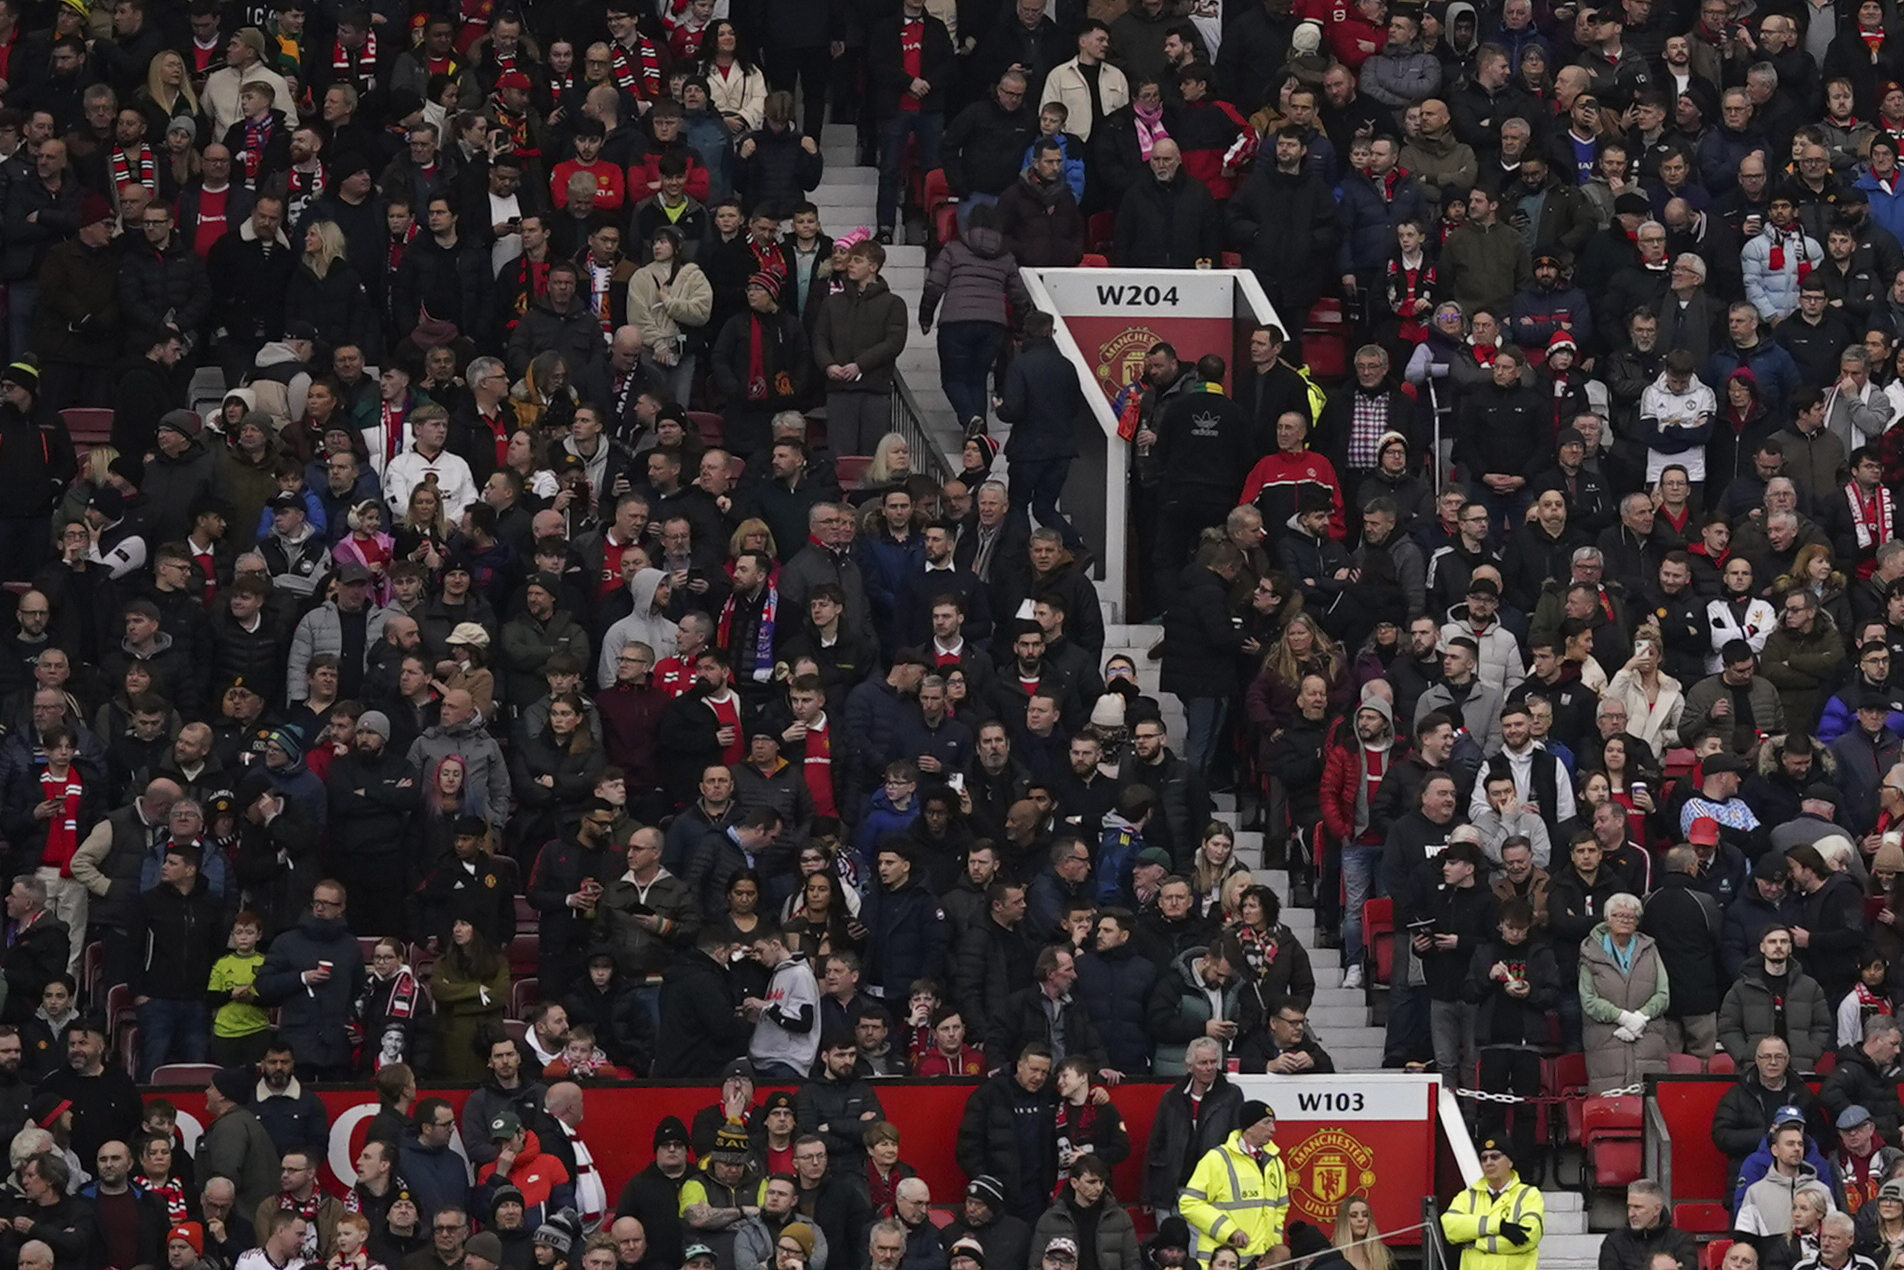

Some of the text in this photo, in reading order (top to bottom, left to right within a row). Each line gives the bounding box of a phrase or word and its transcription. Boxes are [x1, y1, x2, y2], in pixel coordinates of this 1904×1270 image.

[1097, 285, 1179, 307] W204
[1106, 334, 1159, 359] MANCHES
[1297, 1092, 1365, 1112] W103
[1294, 1134, 1368, 1166] MANCHESTER
